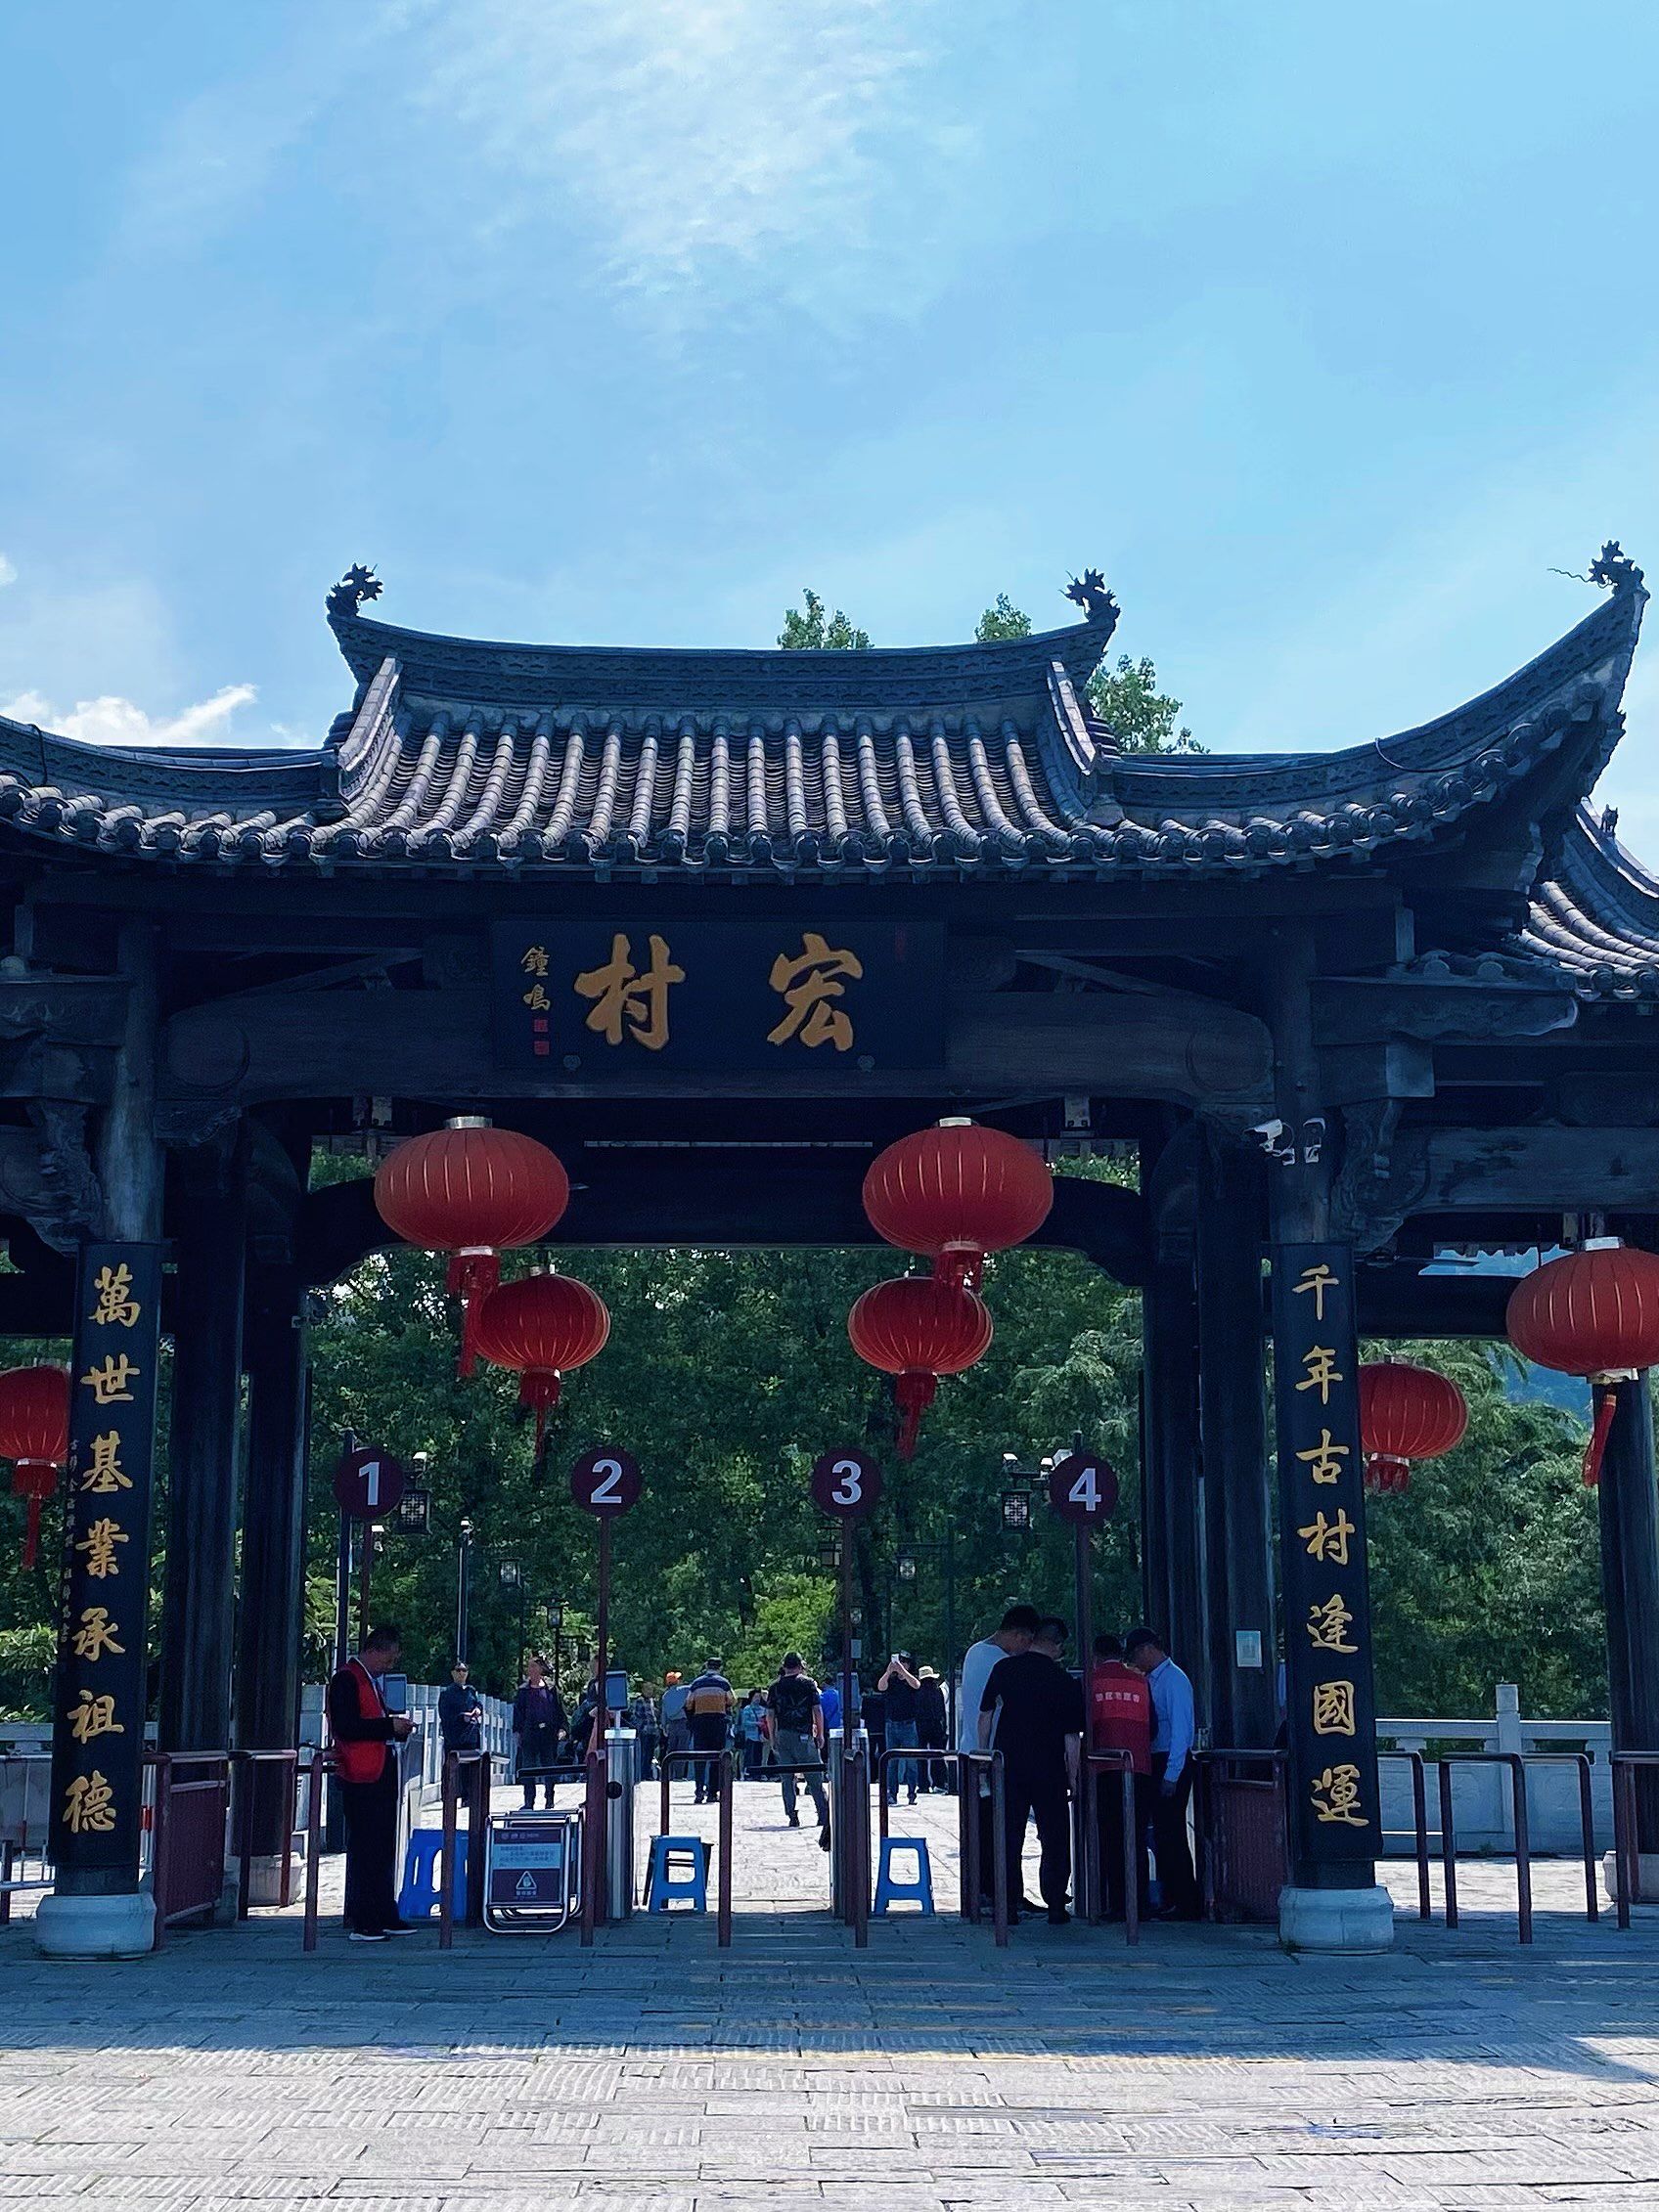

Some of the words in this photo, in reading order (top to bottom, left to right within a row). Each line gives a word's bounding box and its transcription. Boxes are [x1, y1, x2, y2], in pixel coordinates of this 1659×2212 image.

[357, 1461, 381, 1506] 1
[590, 1459, 622, 1504] 2
[831, 1460, 862, 1505] 3
[1068, 1468, 1101, 1512] 4
[63, 1263, 142, 1833] 萬世基業承祖德
[1292, 1264, 1370, 1826] 千年古村逢國運
